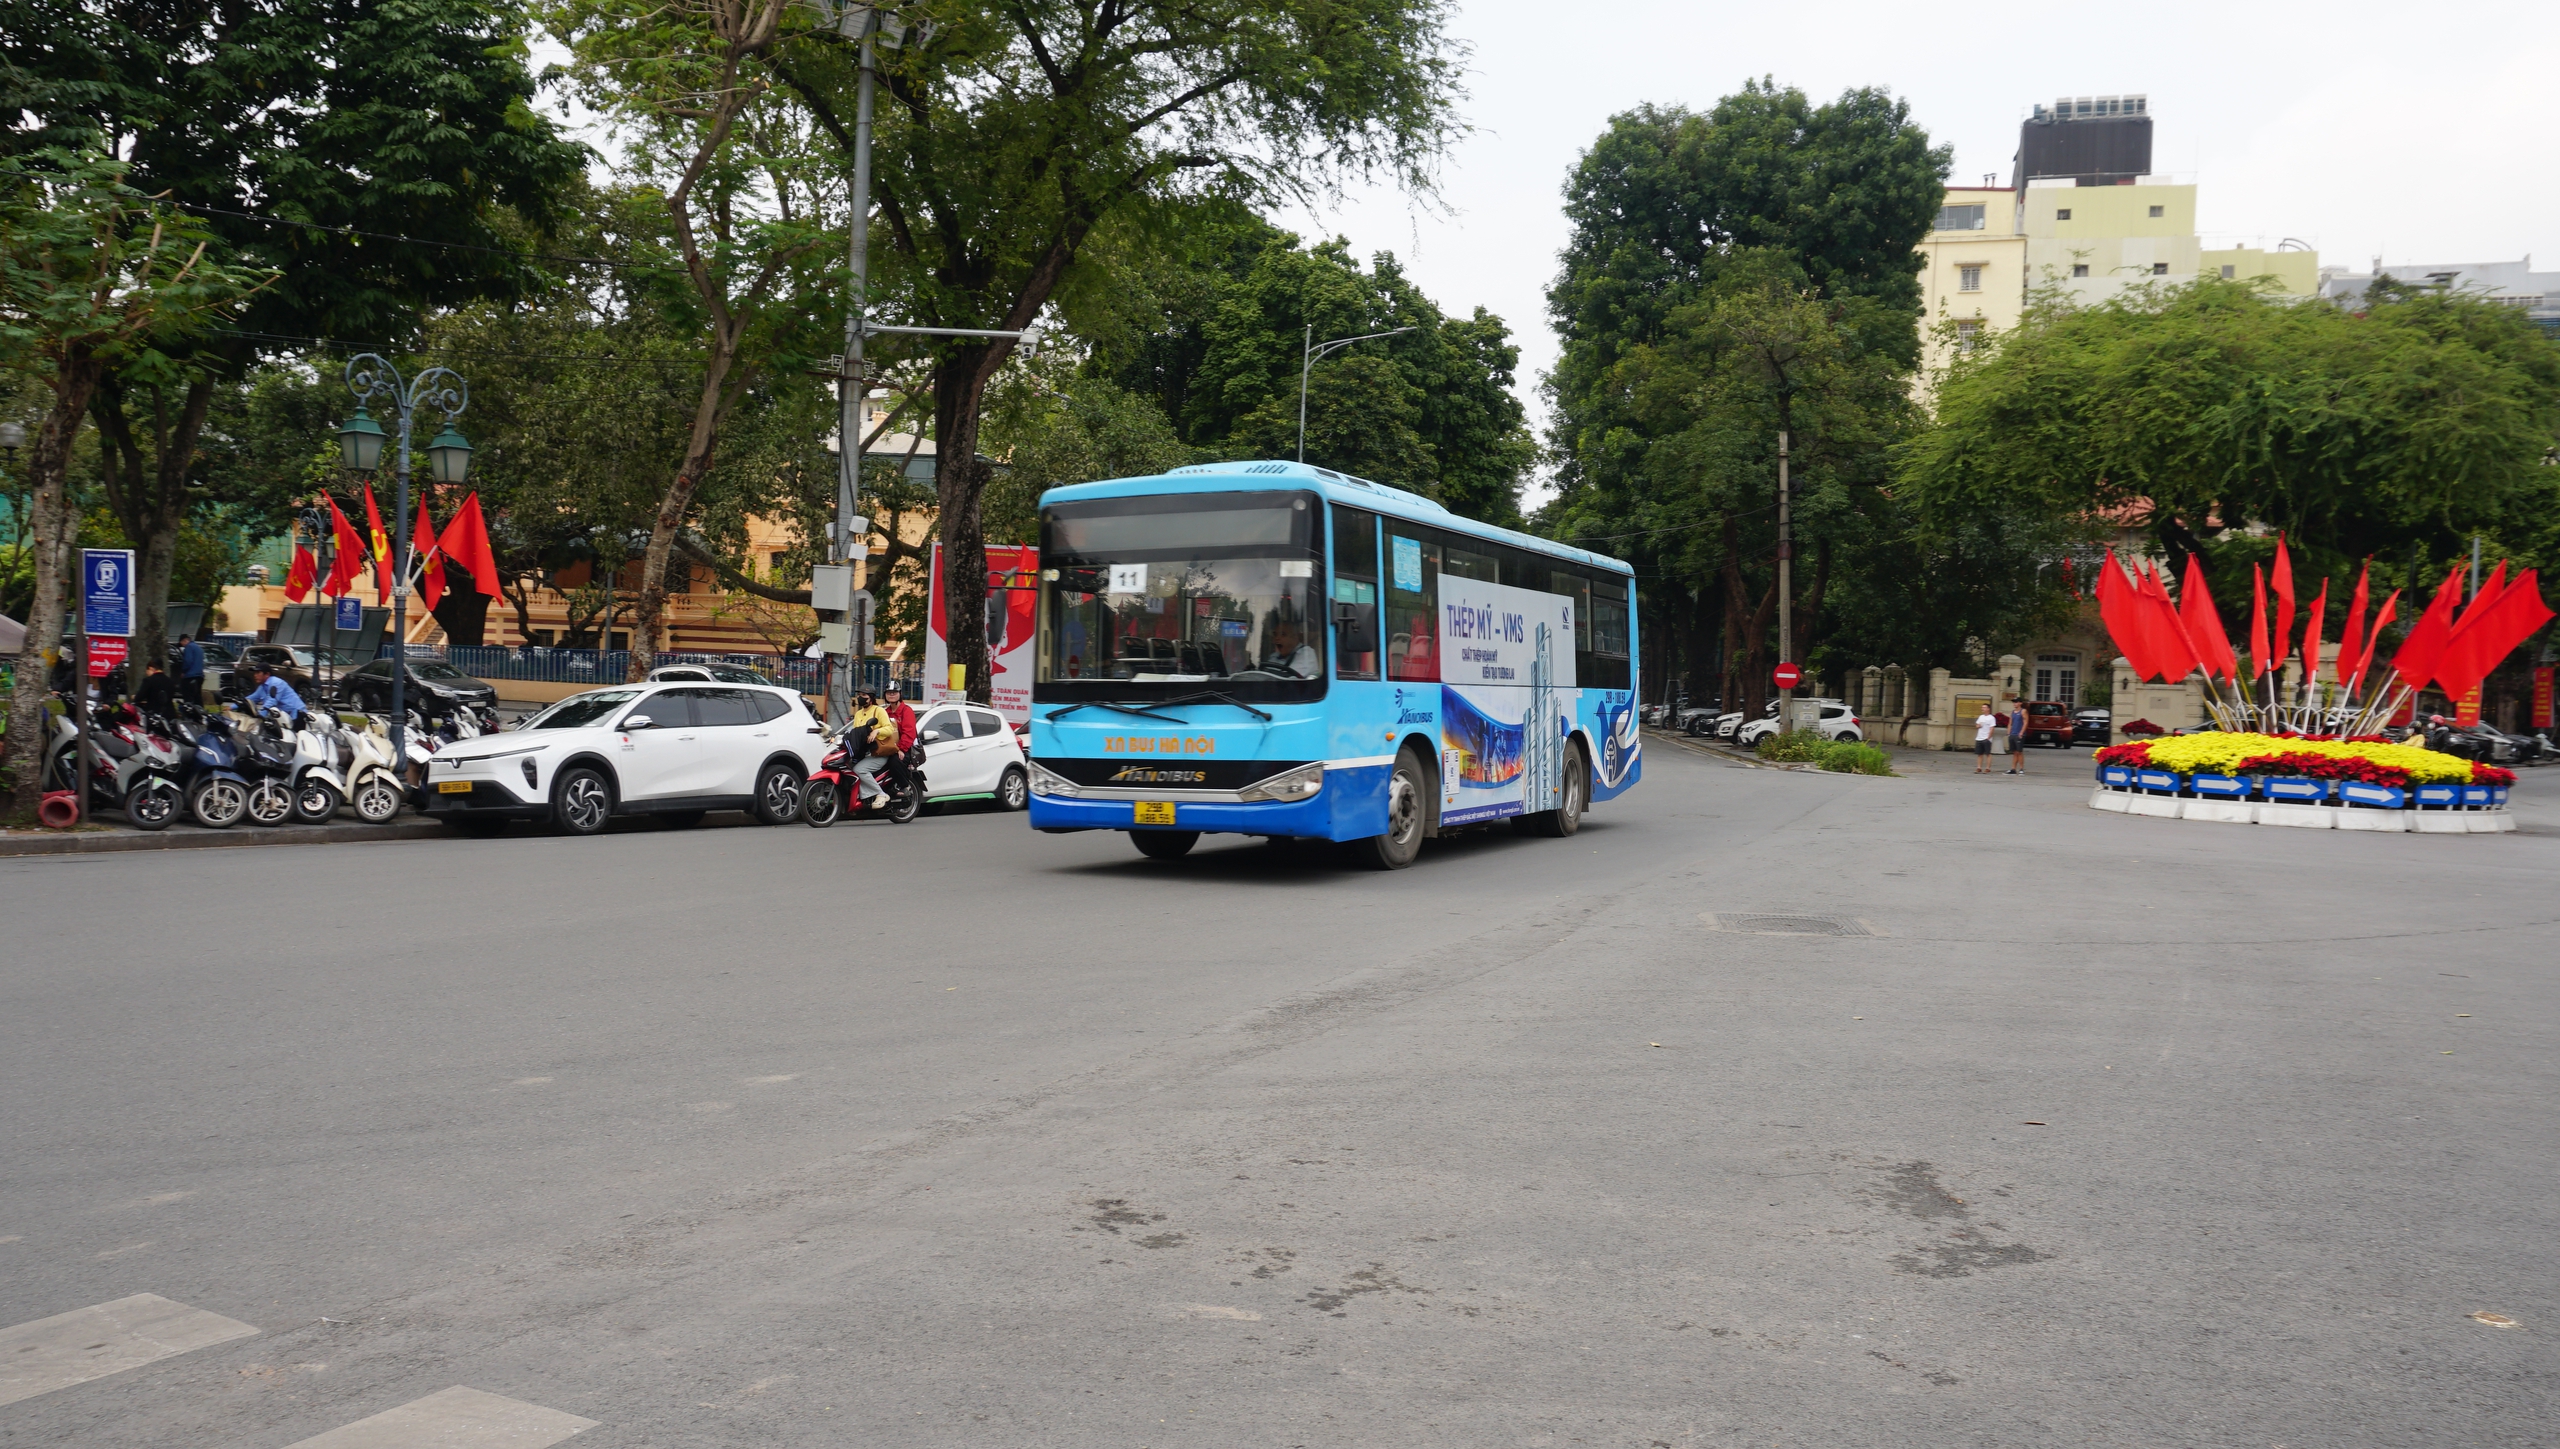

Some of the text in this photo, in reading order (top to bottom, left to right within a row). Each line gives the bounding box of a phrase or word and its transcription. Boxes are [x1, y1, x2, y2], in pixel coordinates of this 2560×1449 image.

[1118, 571, 1137, 586] 11
[1447, 599, 1475, 638] THÉP
[1477, 603, 1492, 640] MỸ
[1502, 612, 1524, 643] VMS
[1128, 736, 1155, 753] BUS
[1159, 733, 1180, 753] HÀ
[1184, 734, 1215, 756] NỘI
